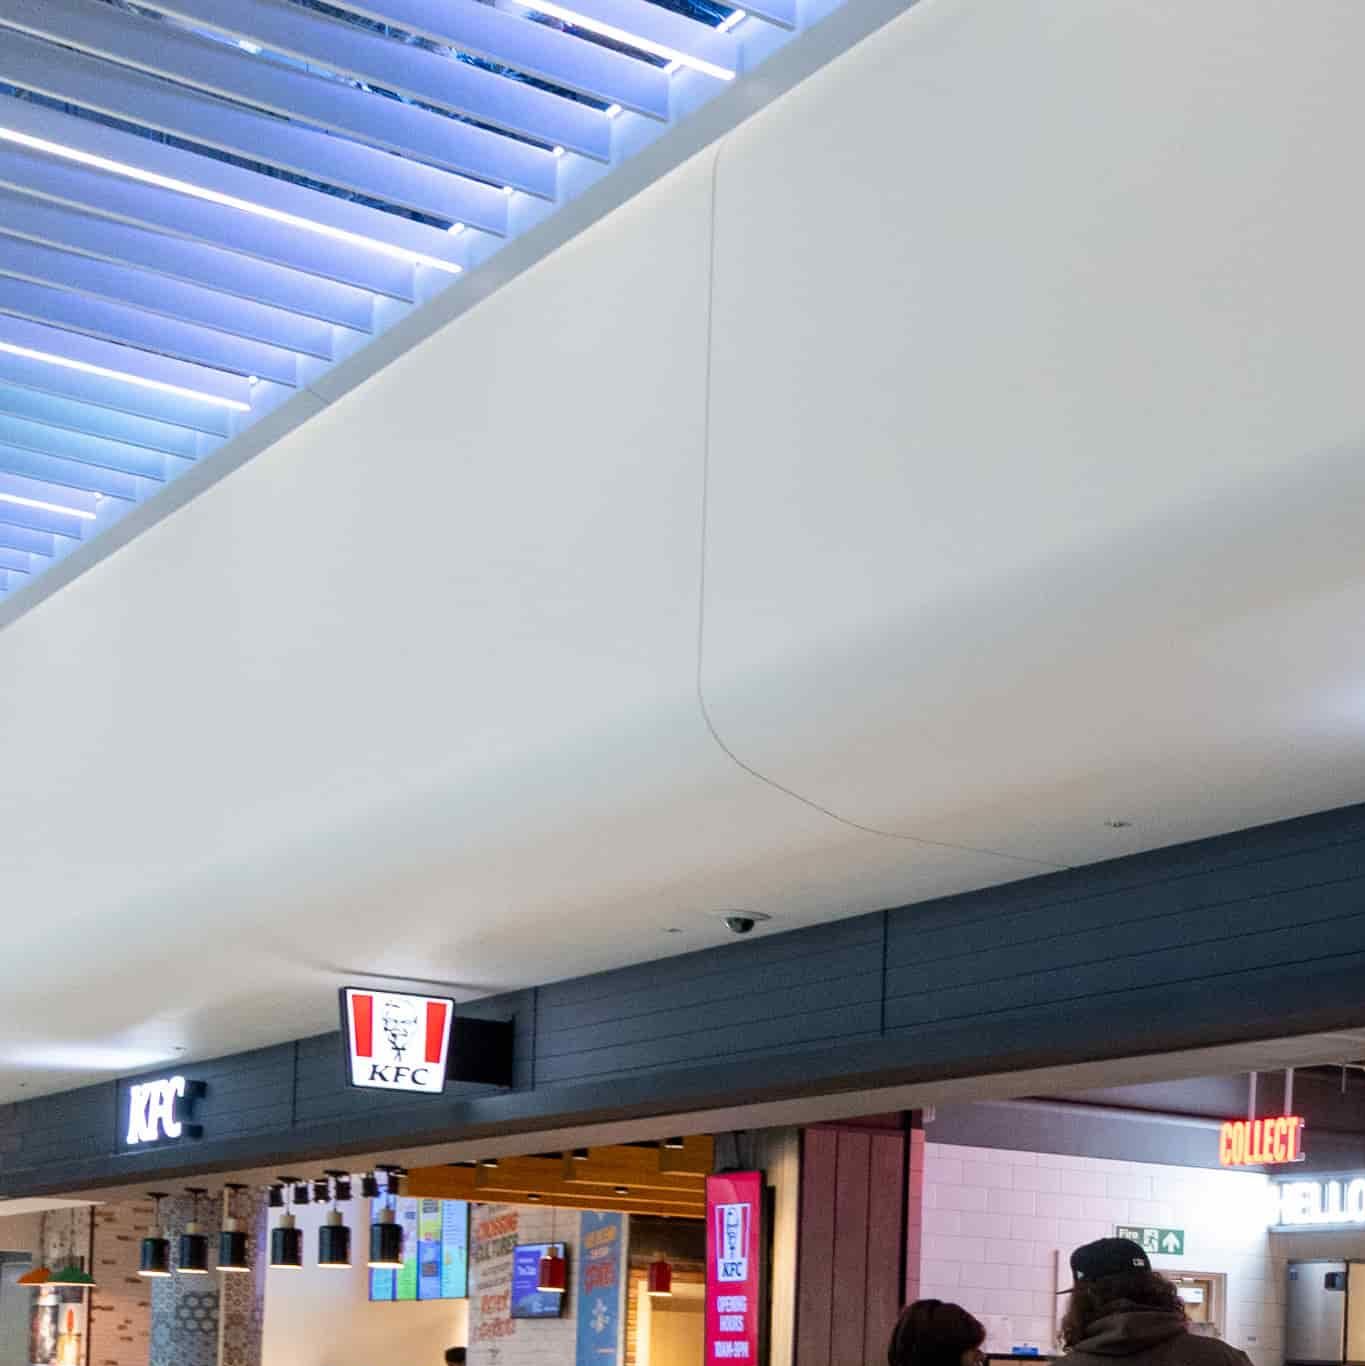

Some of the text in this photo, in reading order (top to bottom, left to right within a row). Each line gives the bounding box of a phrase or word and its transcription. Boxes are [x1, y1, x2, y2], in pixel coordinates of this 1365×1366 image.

[367, 1064, 429, 1087] KFC
[126, 1076, 186, 1145] KFC
[1219, 1117, 1300, 1166] COLLECT
[721, 1261, 743, 1278] KFC
